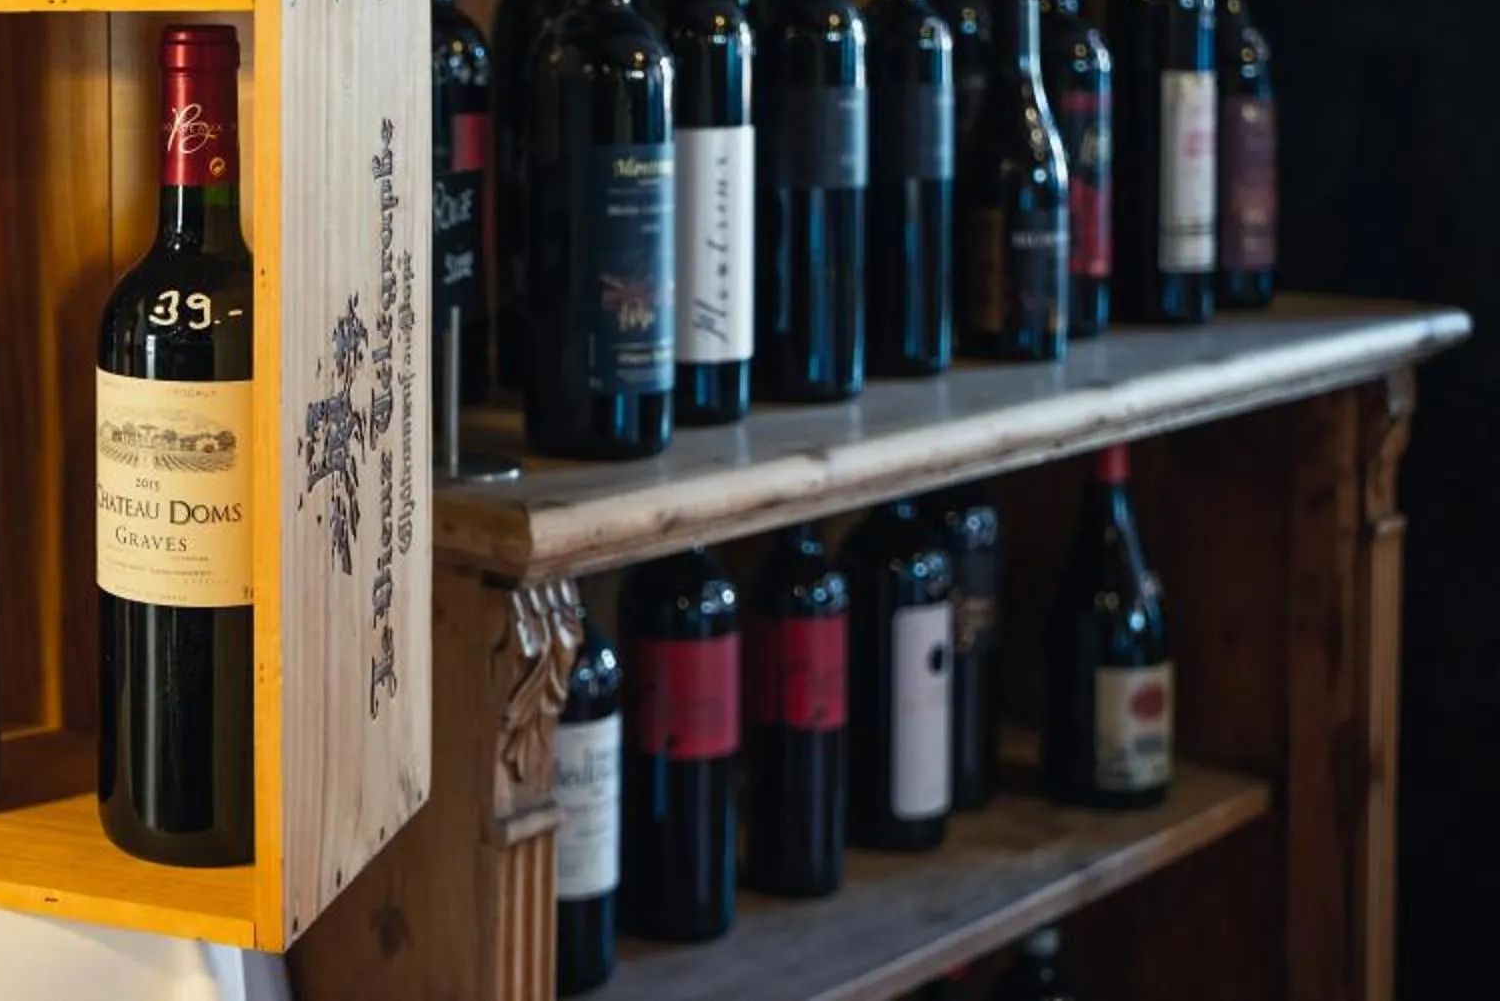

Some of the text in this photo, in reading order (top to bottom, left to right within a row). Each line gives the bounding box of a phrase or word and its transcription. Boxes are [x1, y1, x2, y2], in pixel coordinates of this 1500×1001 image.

[135, 477, 161, 491] 2015
[168, 499, 243, 526] DOMS
[114, 526, 189, 553] GRAVES
